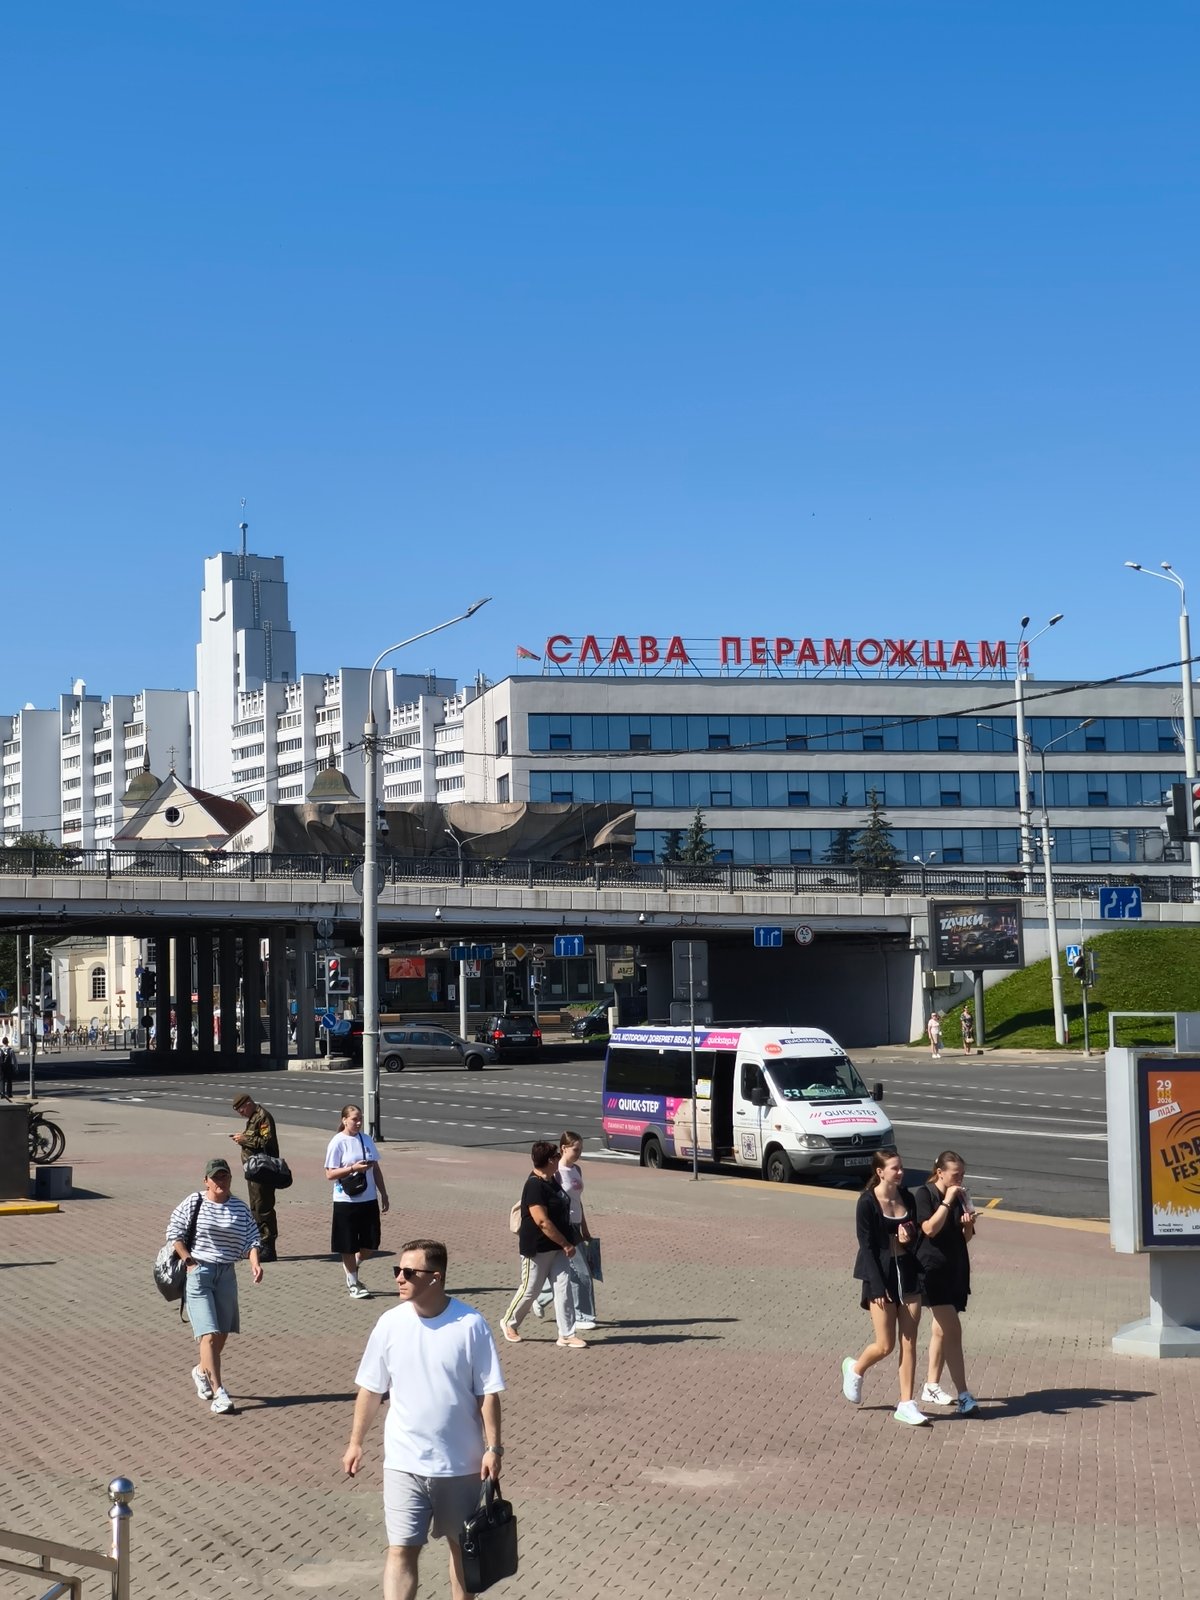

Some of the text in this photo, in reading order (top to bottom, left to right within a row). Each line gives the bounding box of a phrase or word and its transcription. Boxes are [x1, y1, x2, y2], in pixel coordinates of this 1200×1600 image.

[546, 634, 689, 665] СЛАВА
[940, 914, 984, 931] ТАЧКИ
[622, 1033, 649, 1043] КОТОРОМУ
[647, 1034, 674, 1044] ДОВЕРЯЕТ
[687, 1036, 701, 1045] ДМ
[707, 1036, 739, 1047] quickstep.by
[830, 1047, 845, 1056] 53
[1156, 1079, 1172, 1090] 29
[783, 1089, 801, 1097] 53
